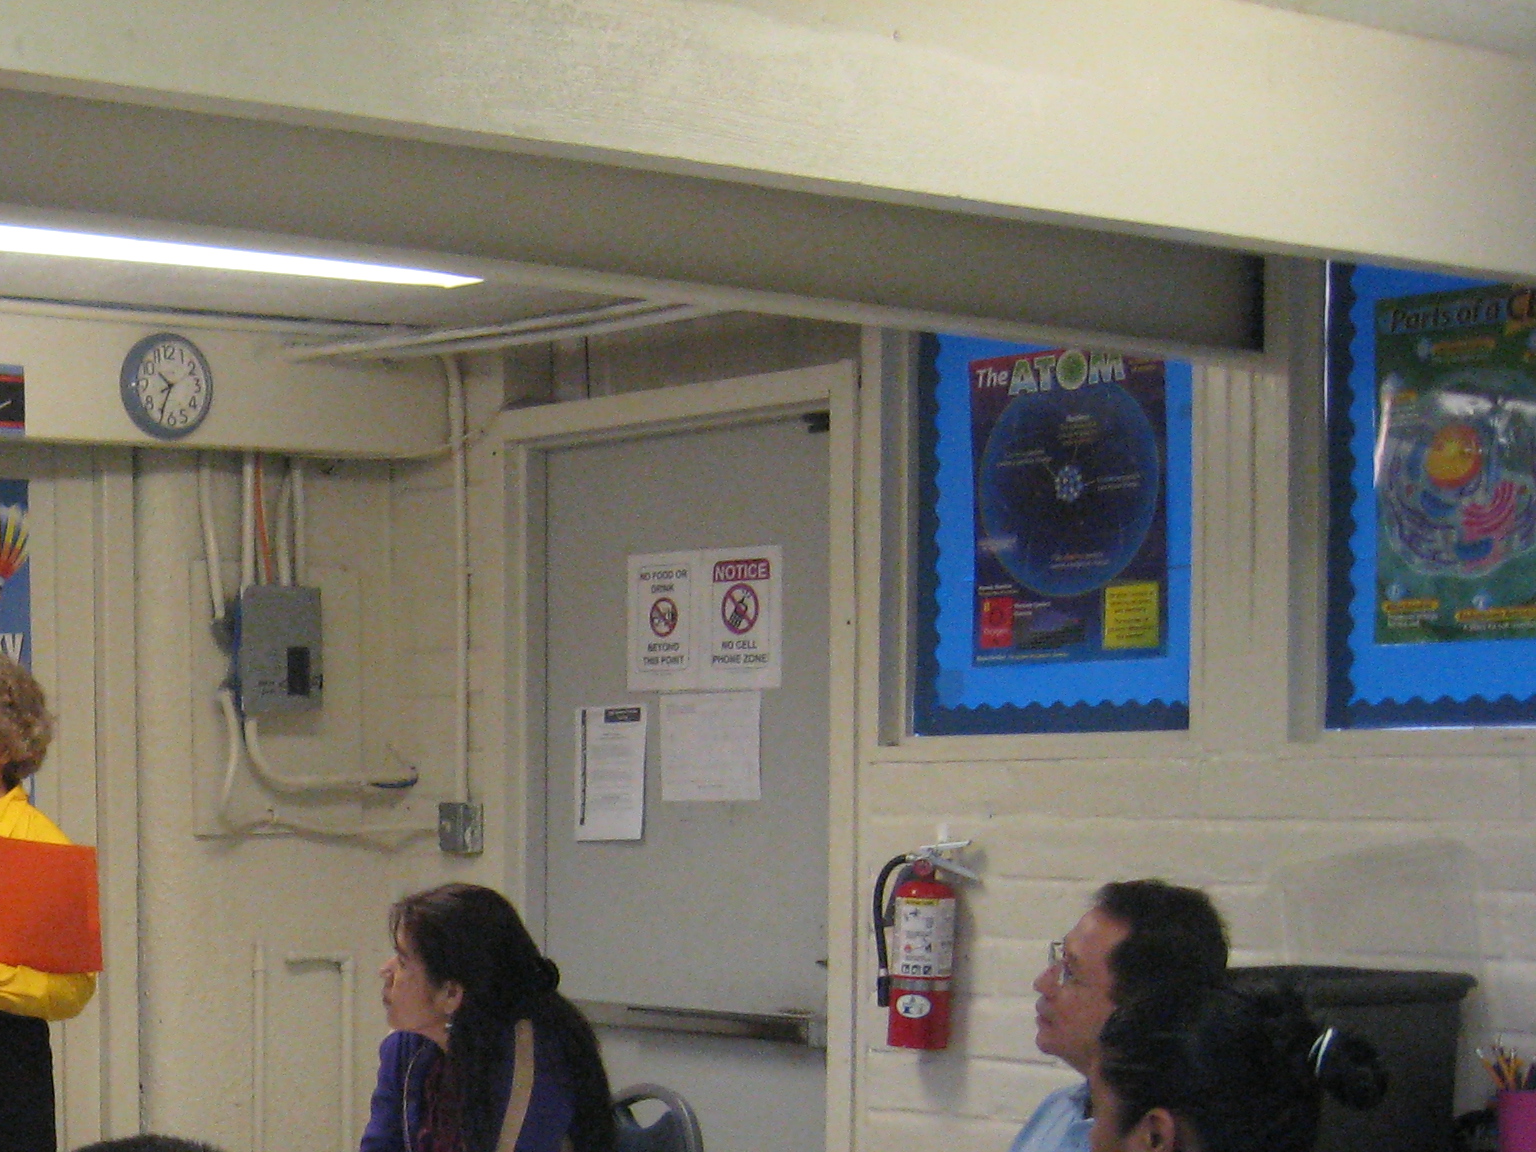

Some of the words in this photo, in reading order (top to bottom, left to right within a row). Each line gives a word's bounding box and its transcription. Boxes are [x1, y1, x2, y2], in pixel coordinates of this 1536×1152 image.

[161, 345, 175, 360] 12
[179, 348, 184, 364] 1
[143, 361, 155, 376] 10
[187, 360, 196, 376] 2
[976, 366, 1009, 389] The
[1008, 349, 1126, 396] ATOM
[194, 378, 202, 394] 3
[145, 395, 154, 411] 8
[188, 395, 197, 410] 4
[167, 411, 177, 427] 6
[179, 408, 188, 425] 5
[652, 570, 674, 580] FOOD
[715, 562, 767, 581] NOTICE
[648, 642, 680, 652] BEYOND
[721, 641, 734, 651] NO
[735, 640, 758, 650] CELL
[661, 655, 684, 665] POINT
[711, 654, 743, 665] PHONE
[743, 653, 768, 664] ZONE
